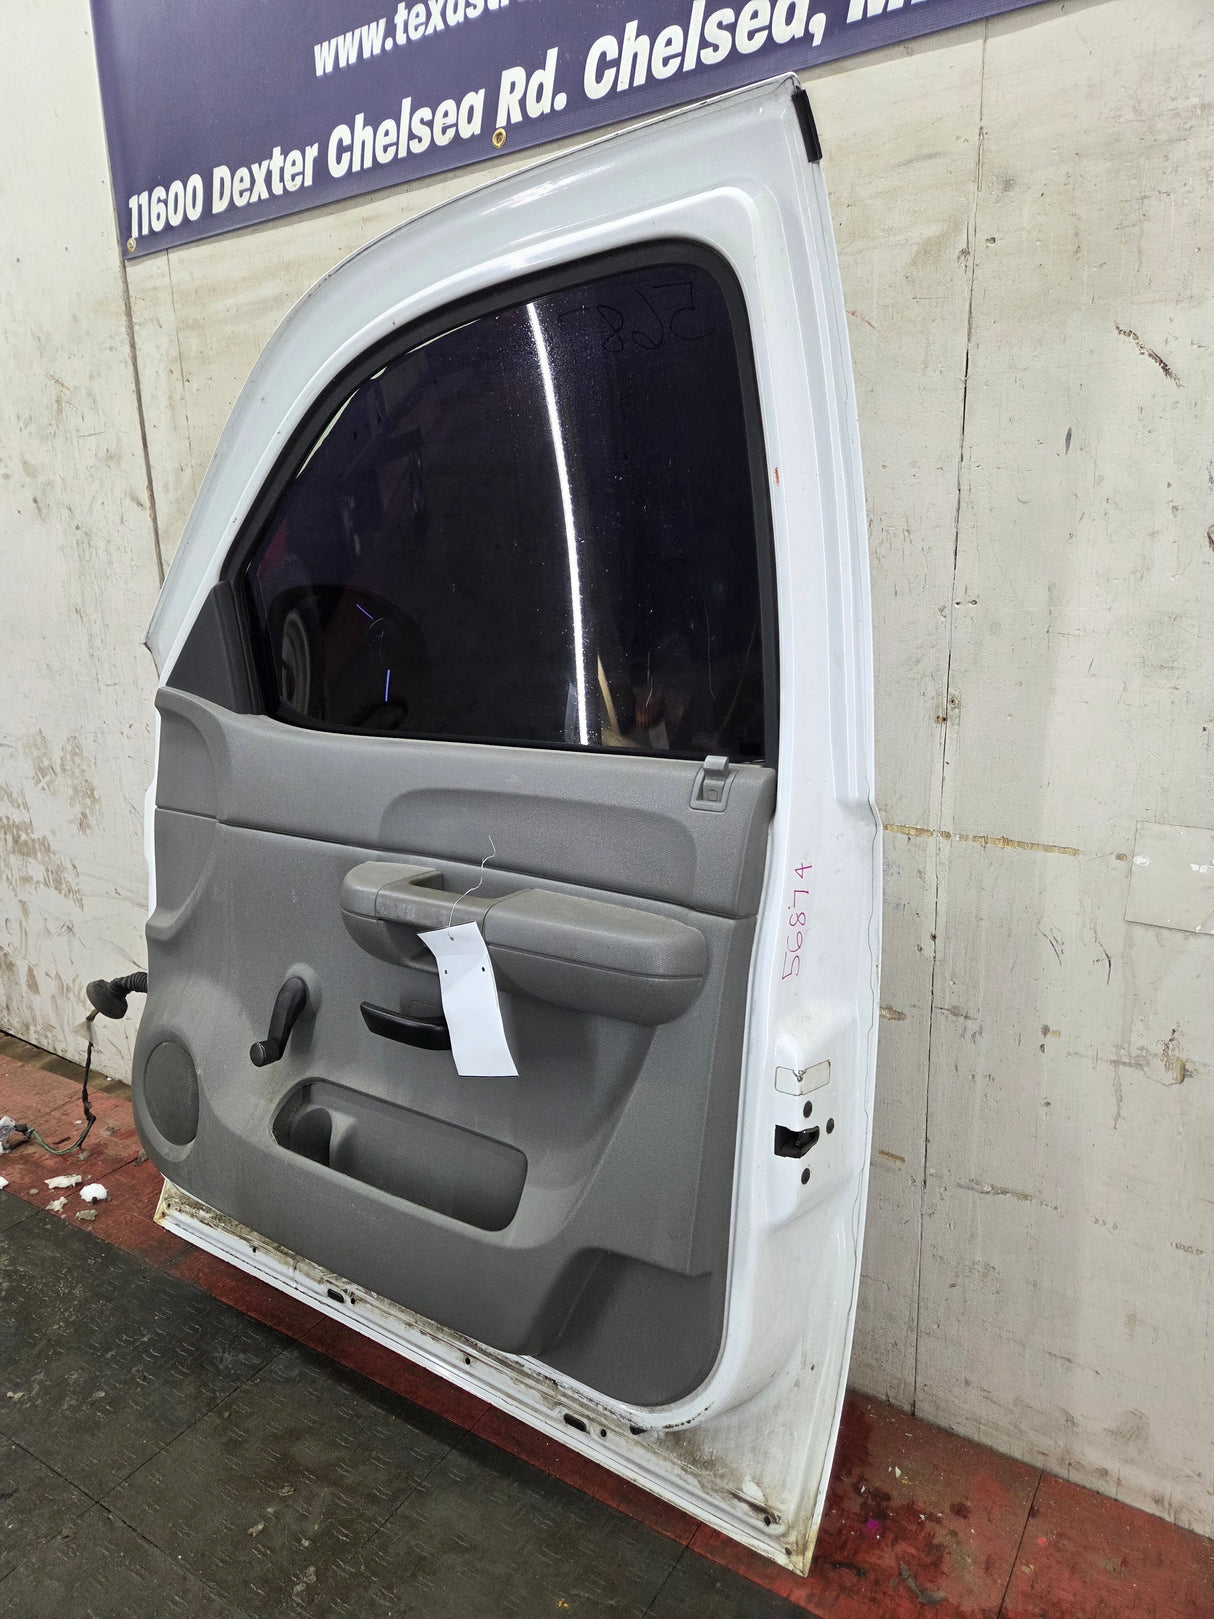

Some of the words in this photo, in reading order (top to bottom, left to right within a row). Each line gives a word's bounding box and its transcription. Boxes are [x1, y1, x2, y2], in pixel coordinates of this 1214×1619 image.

[129, 174, 203, 238] 11600
[212, 143, 318, 214] Dexter
[327, 89, 485, 178] Chelsea
[496, 47, 567, 127] Rd.
[584, 0, 826, 97] Chelsea,
[782, 862, 812, 980] 56874
